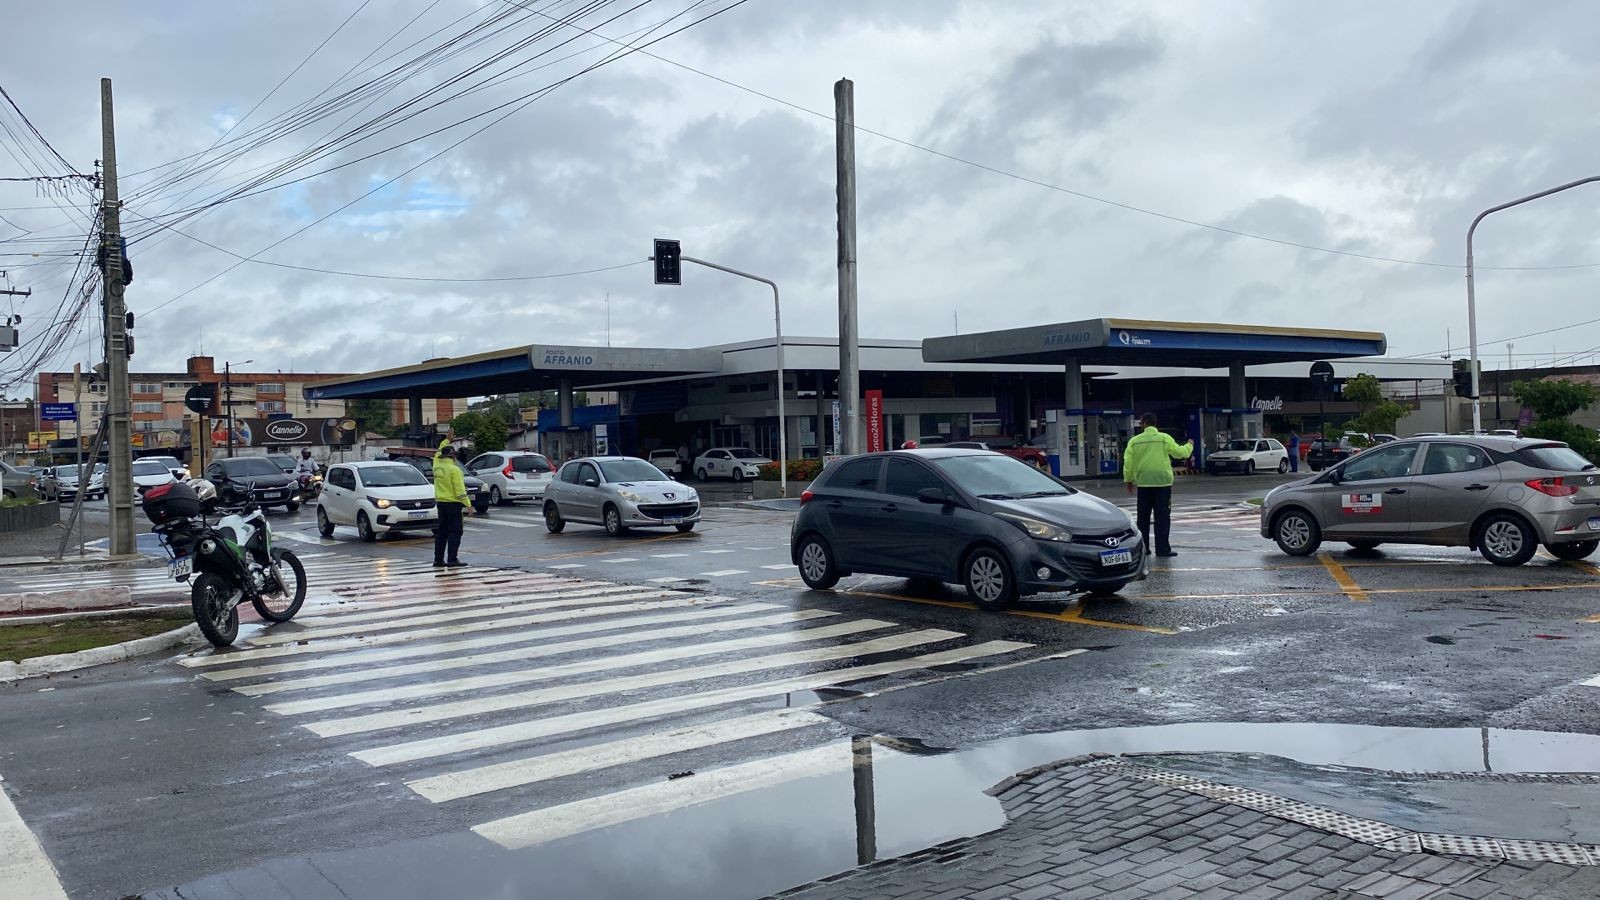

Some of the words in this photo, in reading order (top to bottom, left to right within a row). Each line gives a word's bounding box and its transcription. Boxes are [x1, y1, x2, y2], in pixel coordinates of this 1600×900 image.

[1043, 331, 1090, 346] AFRANIO
[544, 355, 593, 366] AFRANIO
[1251, 395, 1283, 411] Cannelle
[271, 425, 303, 434] Cannelle
